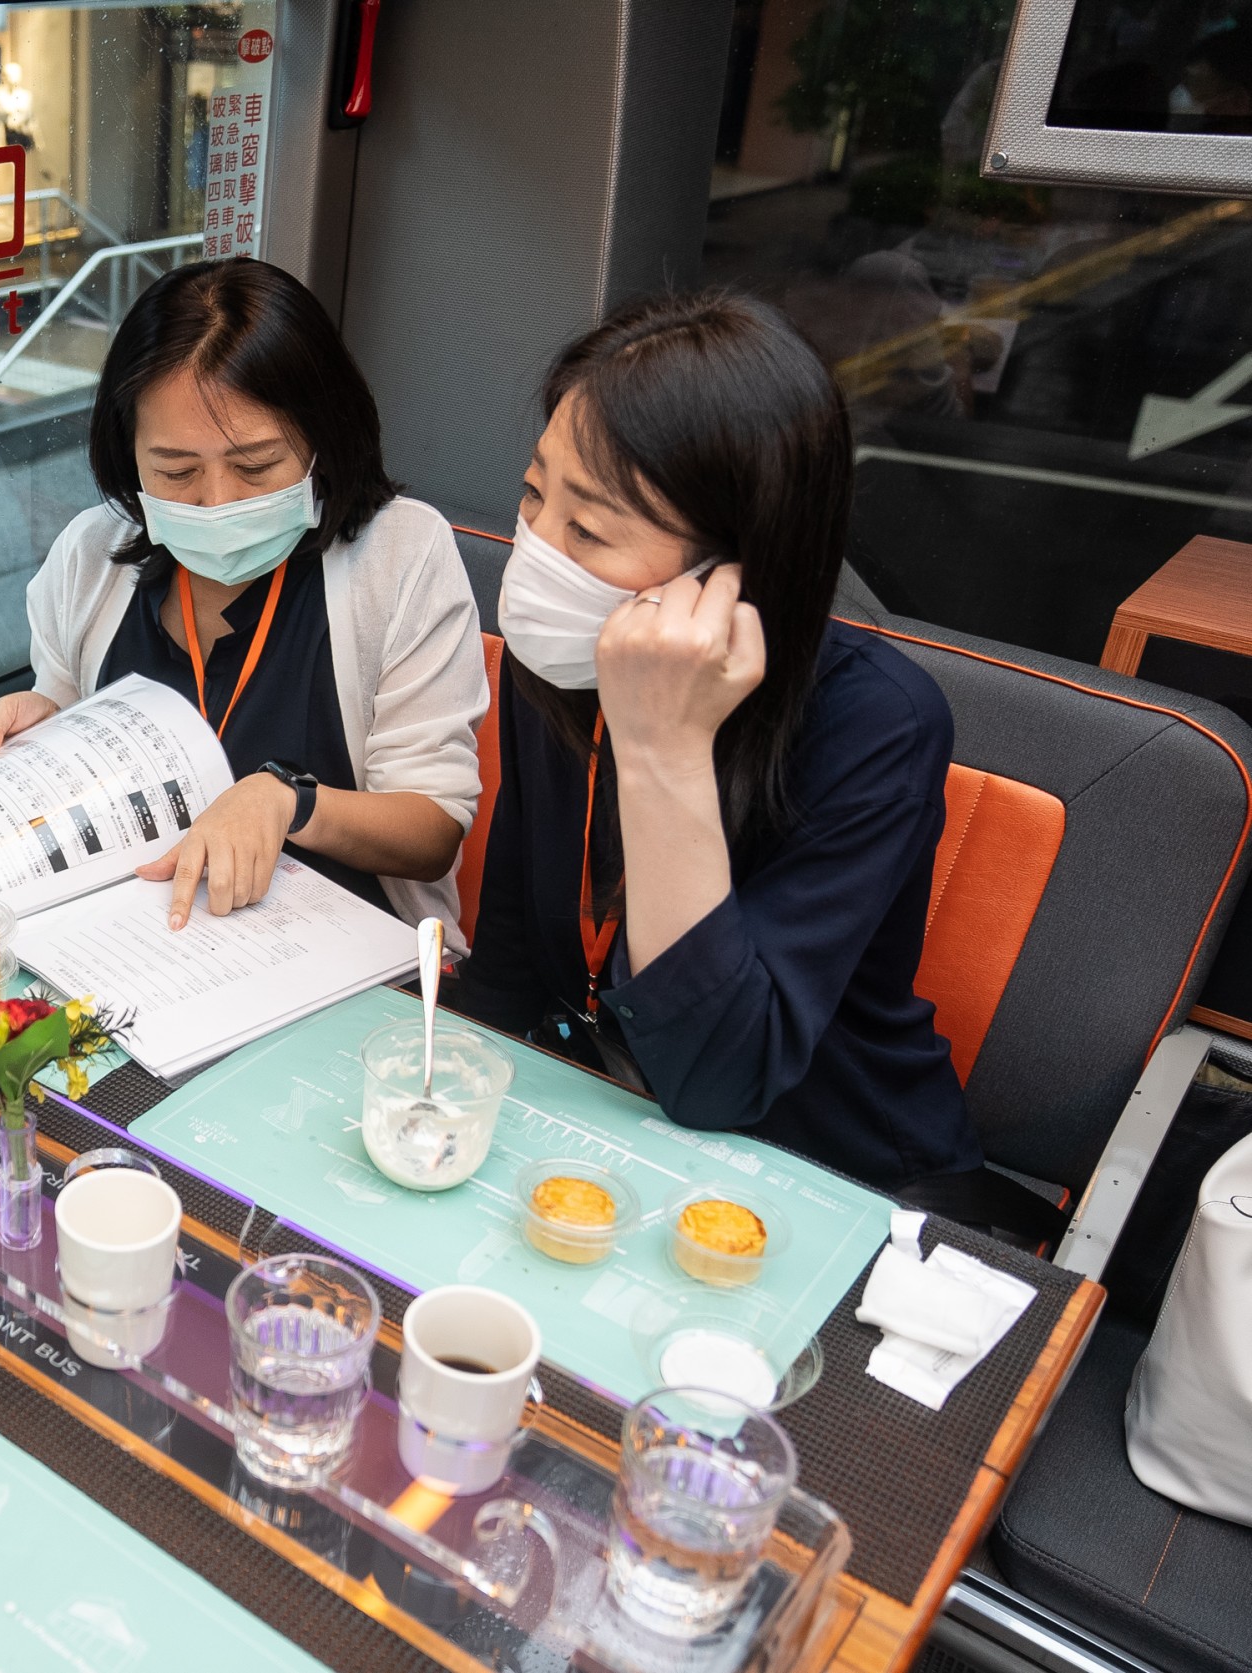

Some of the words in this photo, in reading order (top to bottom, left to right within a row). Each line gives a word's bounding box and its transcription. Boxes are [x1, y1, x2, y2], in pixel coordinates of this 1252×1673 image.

[234, 92, 263, 258] 車窗擊破
[187, 1122, 226, 1146] TAIPEI
[34, 1342, 82, 1377] BUS
